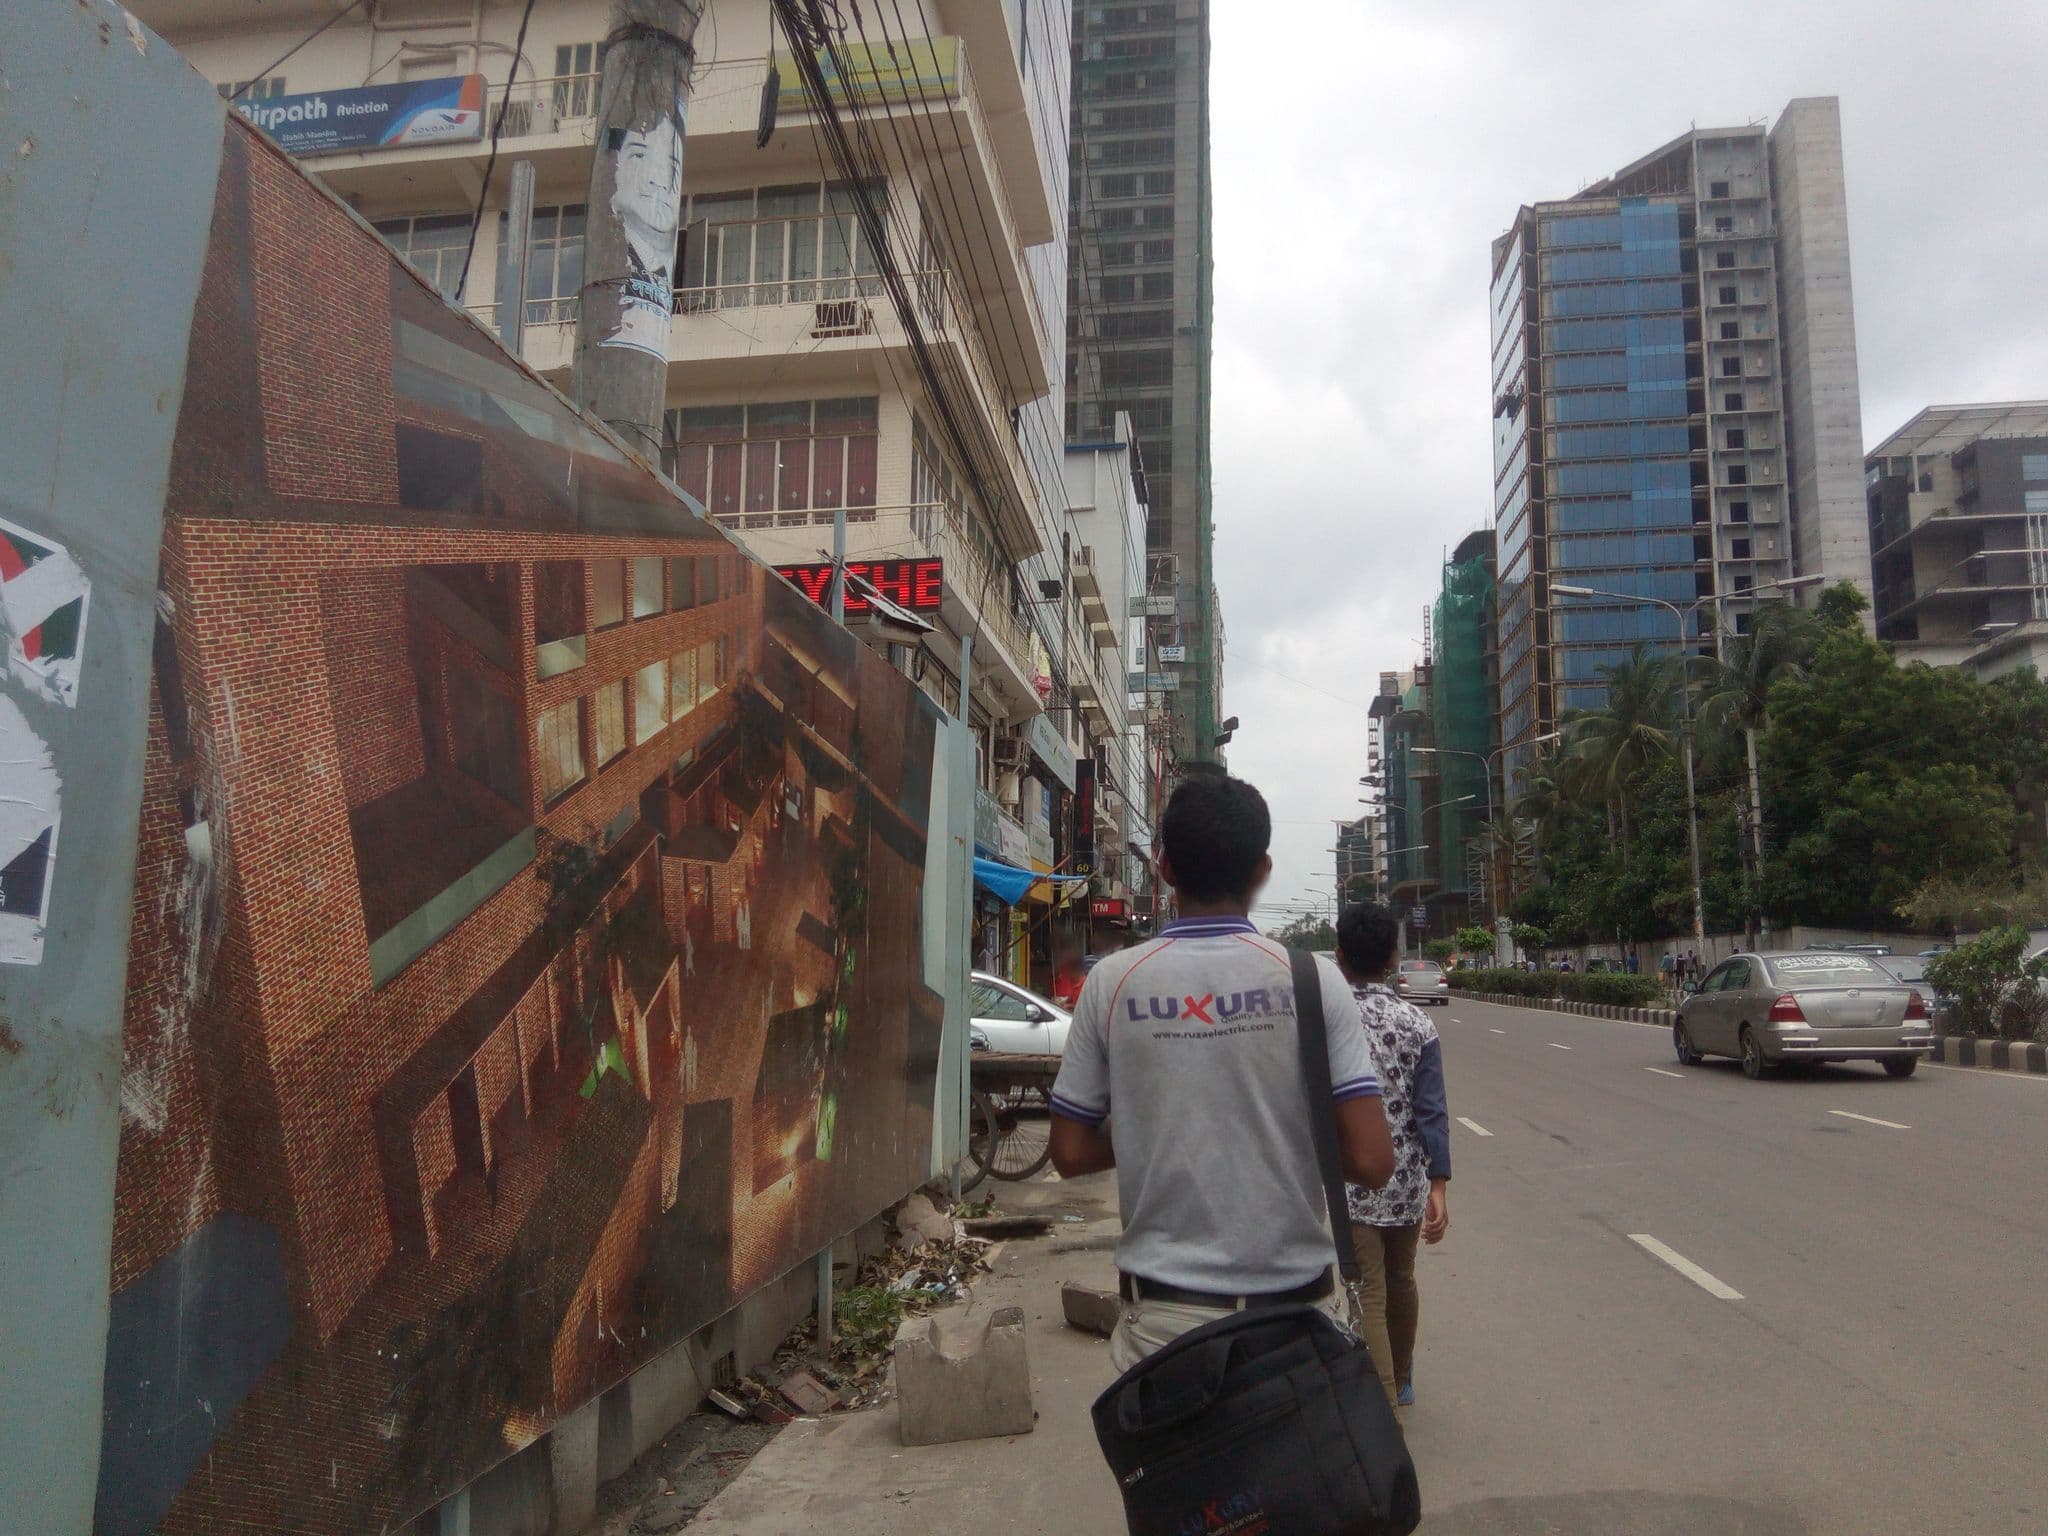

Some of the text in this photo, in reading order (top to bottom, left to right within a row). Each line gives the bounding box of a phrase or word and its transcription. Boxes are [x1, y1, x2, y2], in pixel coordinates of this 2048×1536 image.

[336, 102, 389, 116] Aviation
[411, 125, 455, 134] NOVOAIR
[778, 562, 941, 609] YCHE
[1076, 864, 1089, 872] 60
[1092, 903, 1109, 913] TM
